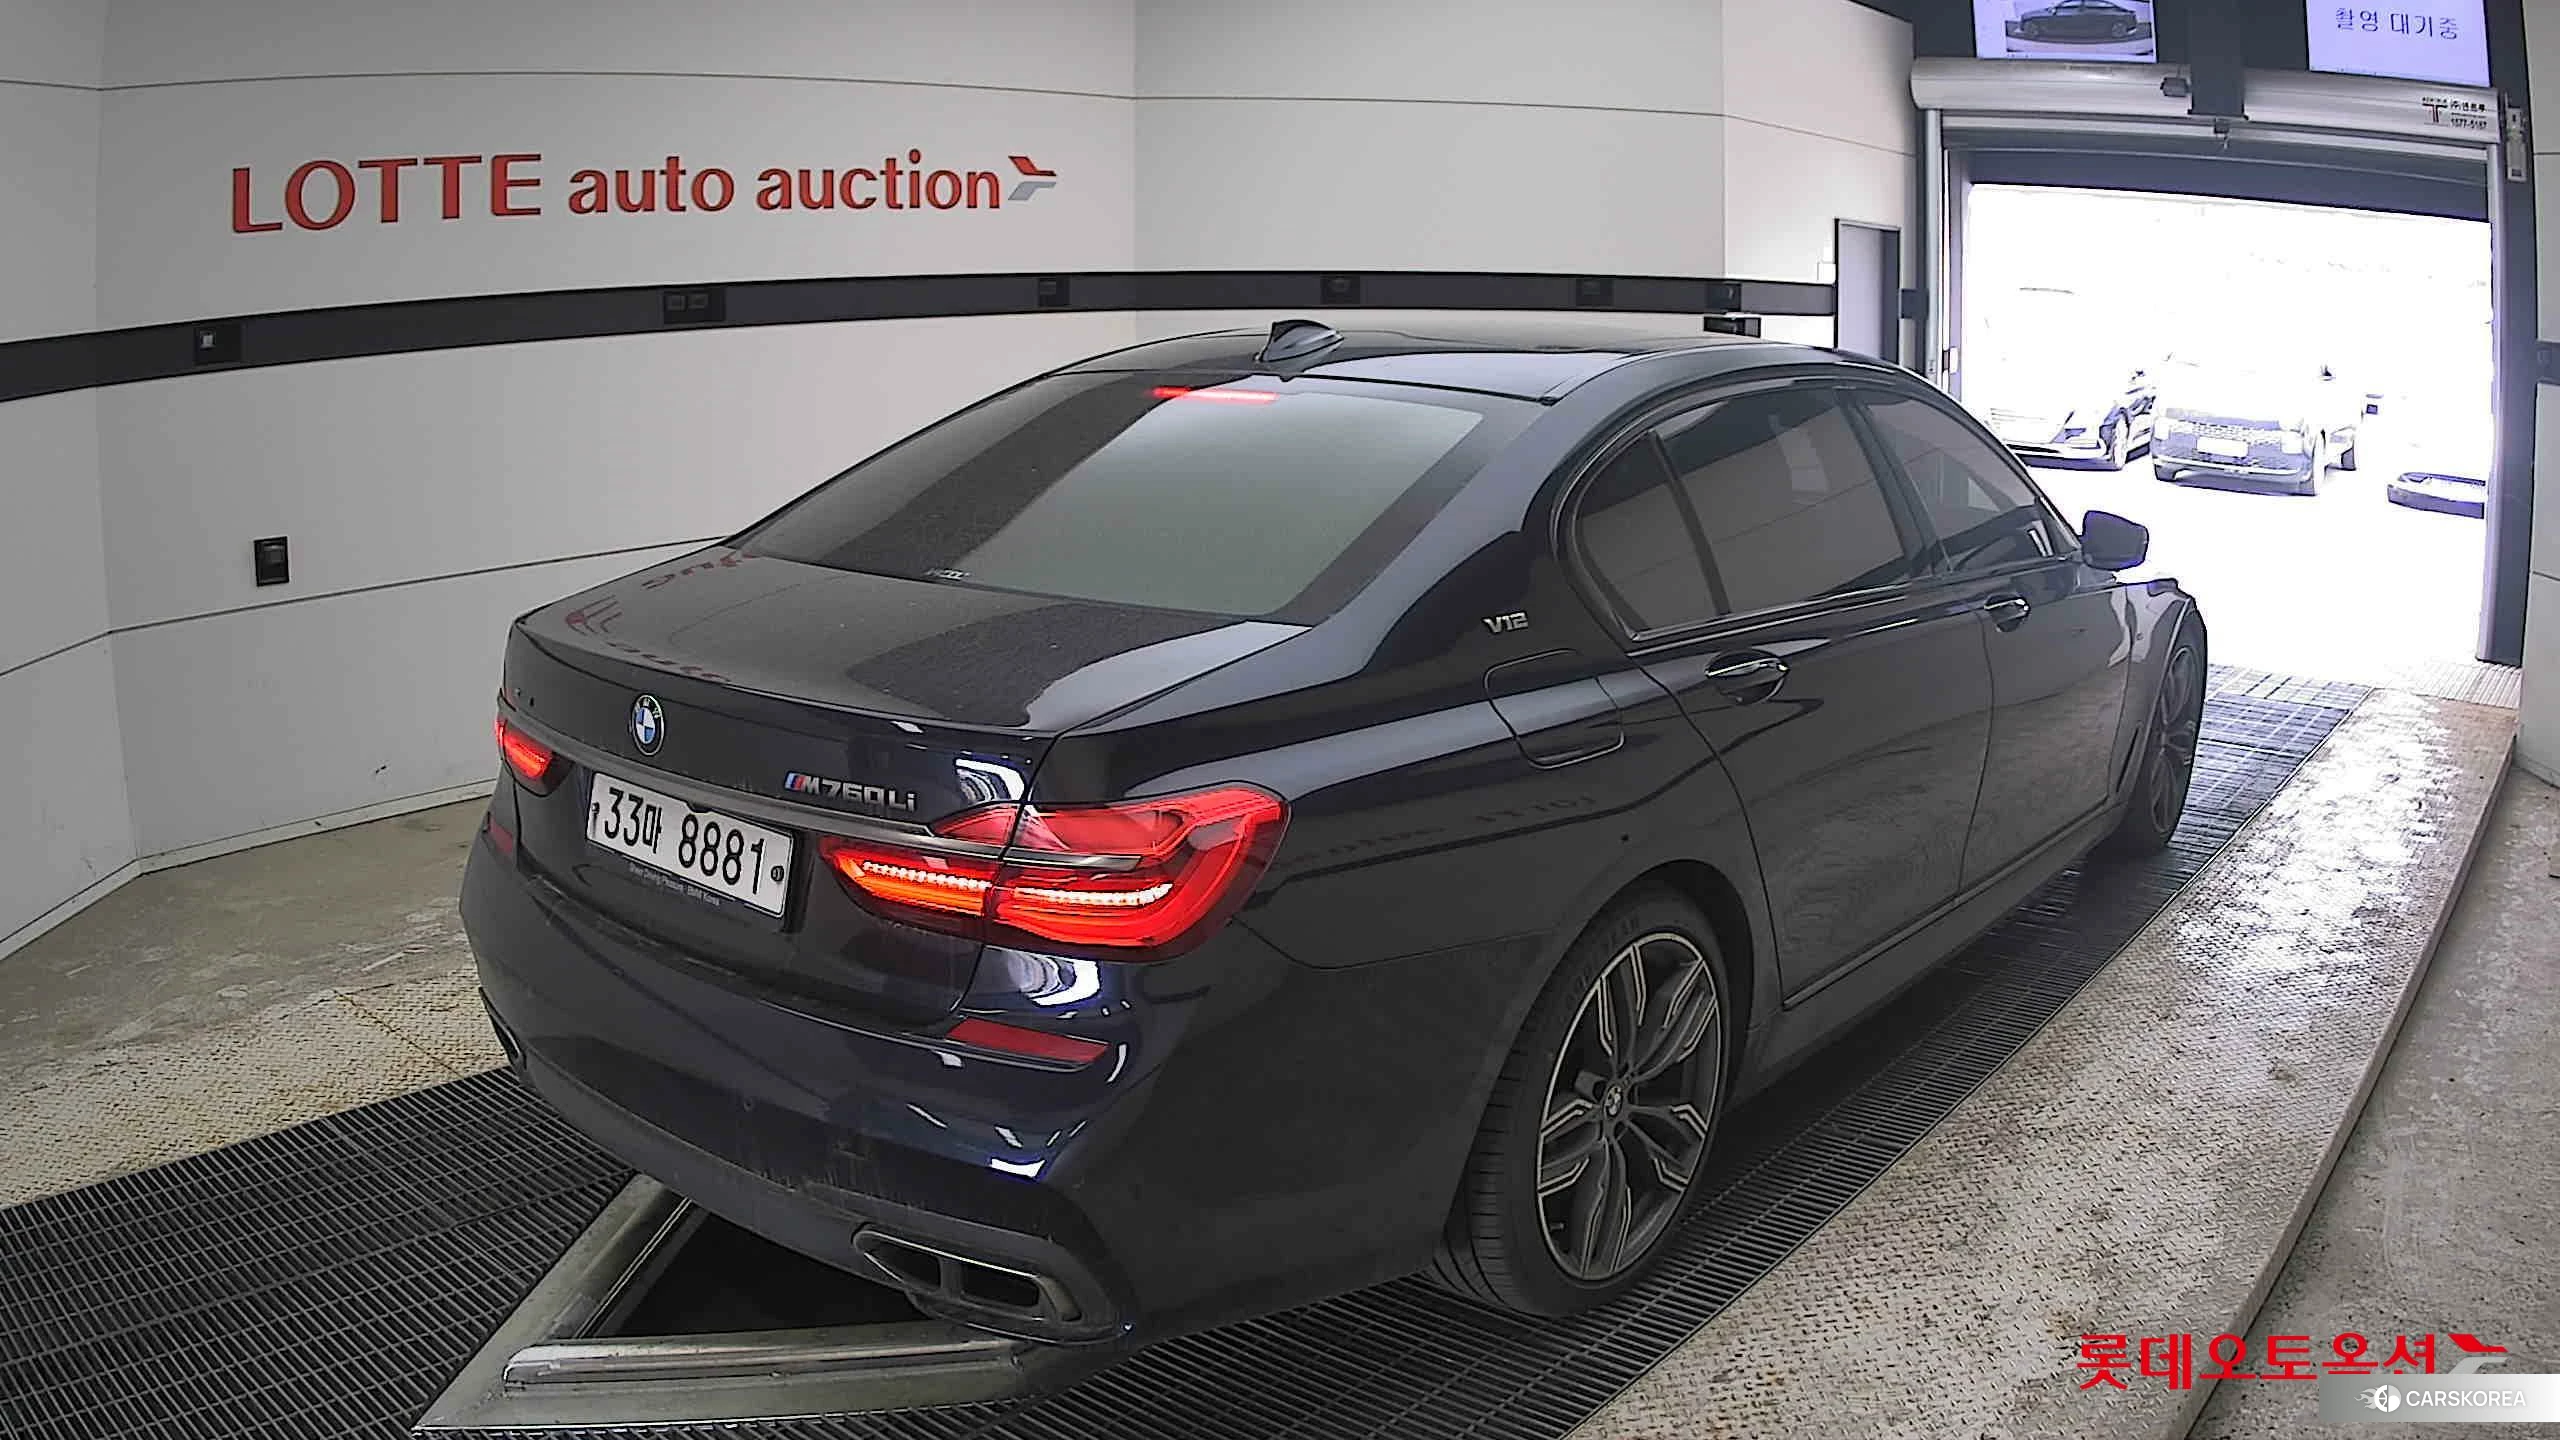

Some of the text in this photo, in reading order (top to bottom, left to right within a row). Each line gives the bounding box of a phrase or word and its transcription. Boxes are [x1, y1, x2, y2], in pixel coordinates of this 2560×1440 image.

[2336, 8, 2457, 40] 촬영 대기중
[232, 150, 1003, 233] LOTTE auto auction
[1482, 612, 1528, 633] V12
[604, 787, 662, 853] 33마
[679, 813, 765, 895] 8881
